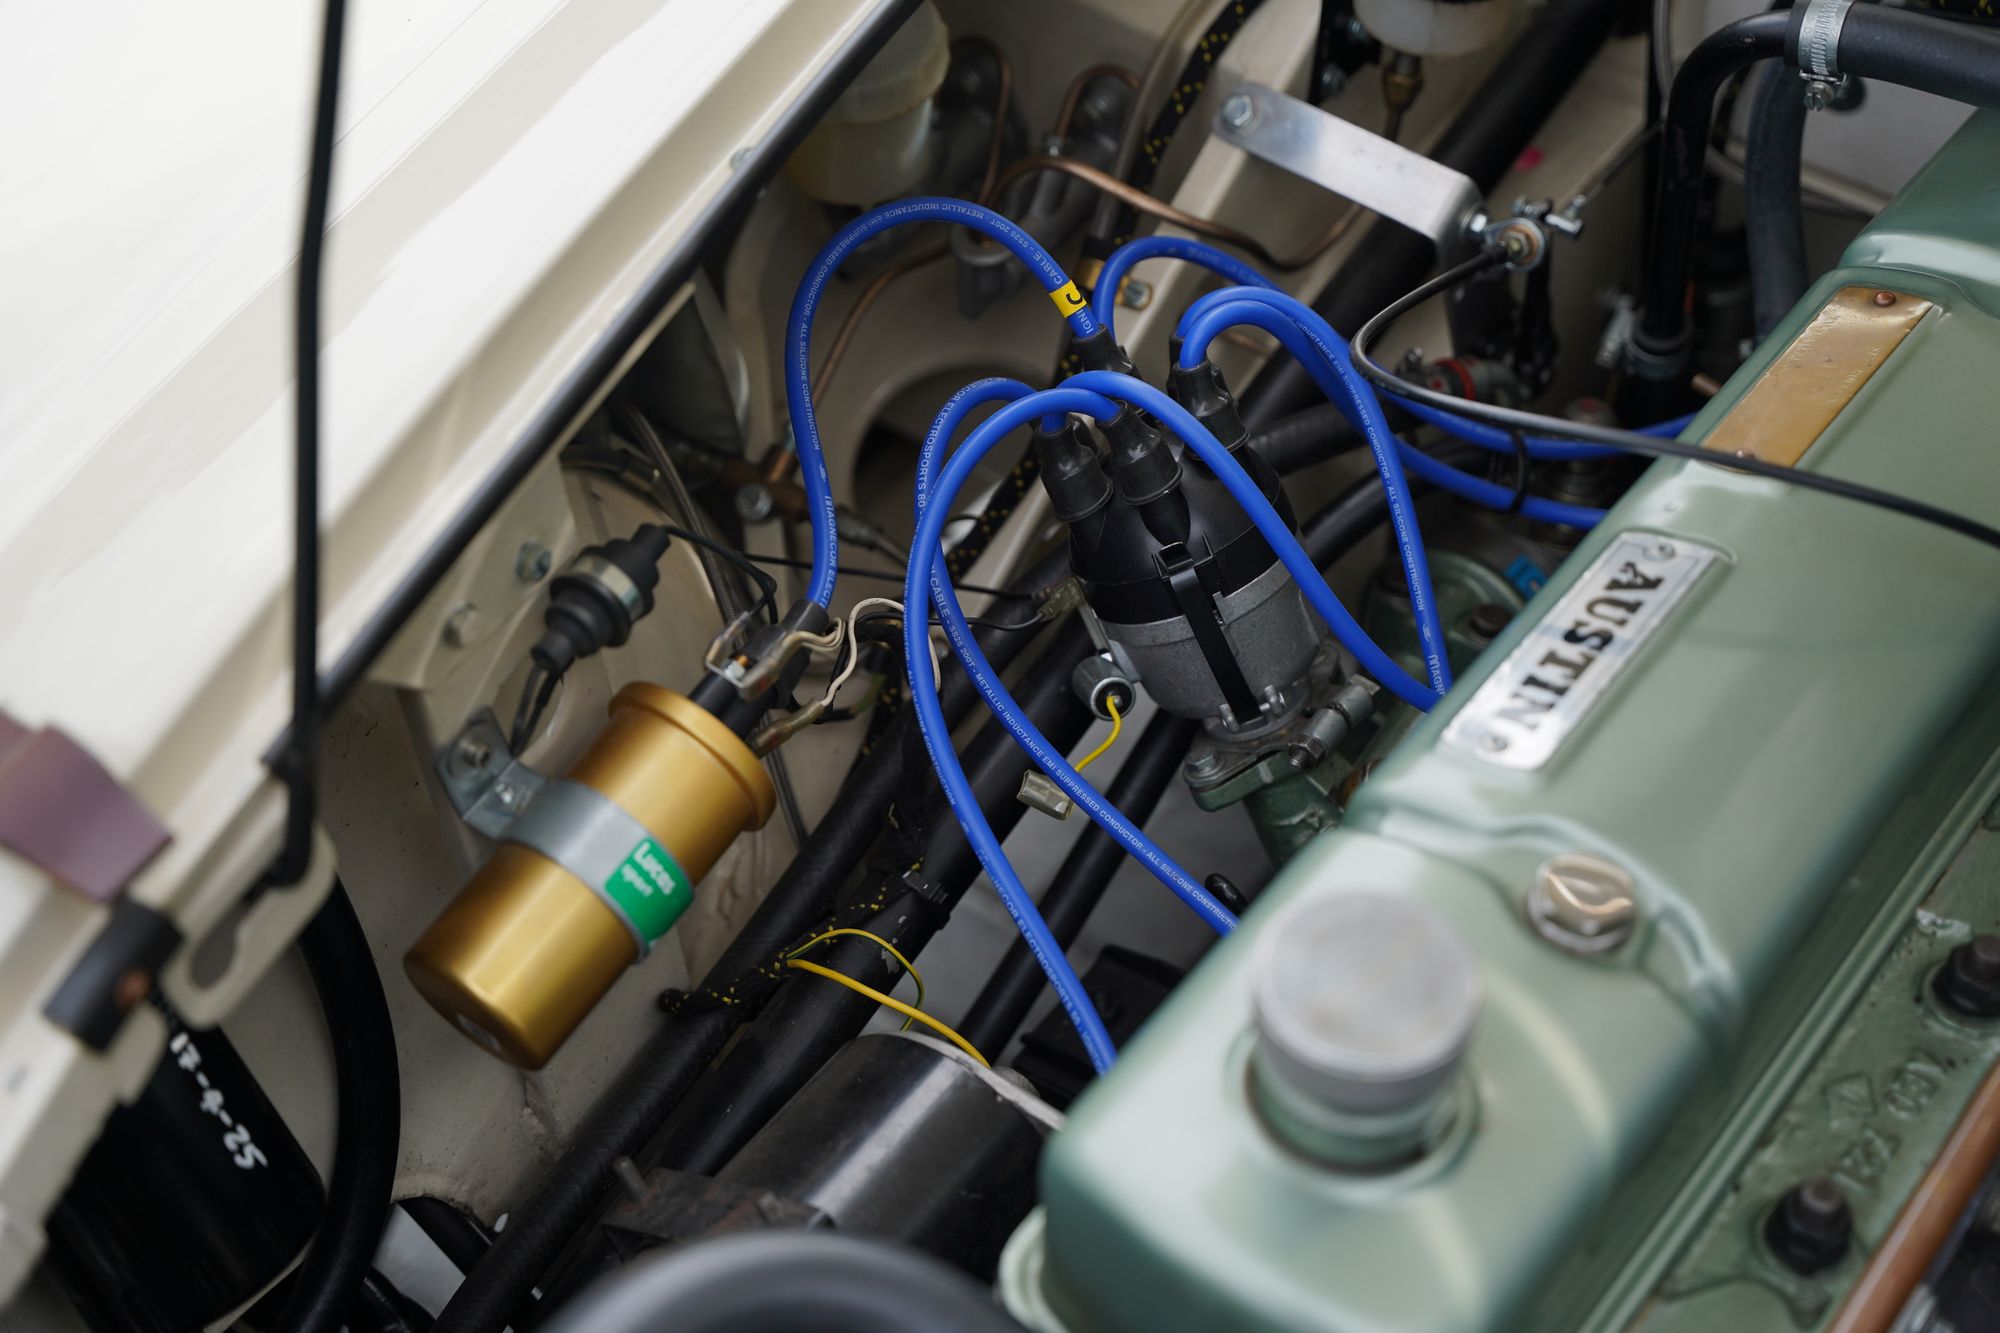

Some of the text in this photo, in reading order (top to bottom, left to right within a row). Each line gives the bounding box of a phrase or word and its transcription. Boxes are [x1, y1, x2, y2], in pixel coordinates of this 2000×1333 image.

[883, 202, 940, 220] INDUCTANCE
[942, 202, 985, 220] METALLIC
[826, 223, 868, 266] SUPPRESSED
[1010, 230, 1029, 248] SS25
[803, 265, 828, 317] CONDUCTOR
[1033, 250, 1063, 285] CABLE
[800, 322, 809, 339] ALL
[800, 341, 808, 381] SILICONE
[802, 383, 821, 450] CONSTRUCTION
[917, 402, 954, 491] ELECTROSPORTS
[917, 493, 927, 508] 80
[1343, 375, 1370, 426] SUPPRESSED
[1368, 427, 1390, 480] CONDUCTOR
[1388, 486, 1398, 502] ALL
[1393, 503, 1409, 543] SILICONE
[1404, 544, 1425, 611] CONSTRUCTION
[1491, 561, 1665, 731] AUSTIN
[930, 577, 951, 617] CABLE
[949, 626, 963, 647] SS25
[960, 647, 976, 668] 200T
[975, 673, 1004, 711] METALLIC
[1002, 711, 1044, 757] INDUCTANCE
[1042, 753, 1057, 771] EMI
[1055, 769, 1100, 811] SUPPRESSED
[1099, 810, 1144, 849] CONDUCTOR
[1146, 852, 1160, 865] ALL
[1160, 863, 1193, 893] SILICONE
[924, 735, 956, 806] CONSTRUCTION
[633, 841, 677, 896] Lucas
[169, 1031, 269, 1170] 17-4-25
